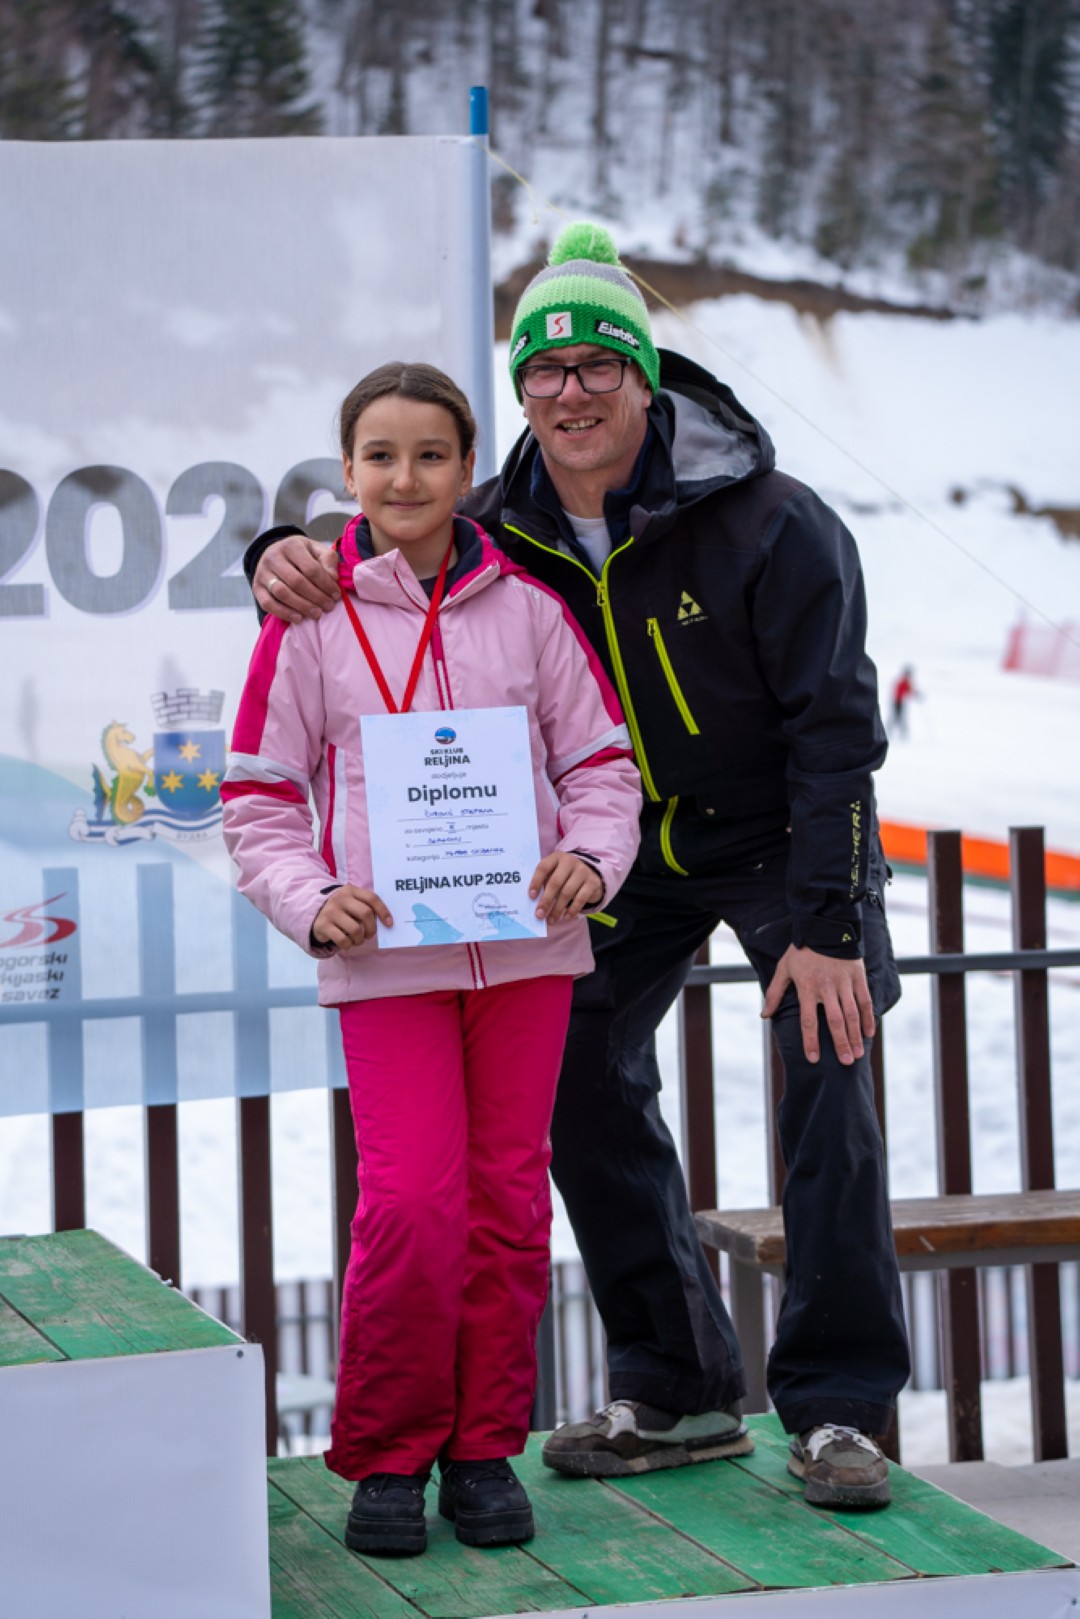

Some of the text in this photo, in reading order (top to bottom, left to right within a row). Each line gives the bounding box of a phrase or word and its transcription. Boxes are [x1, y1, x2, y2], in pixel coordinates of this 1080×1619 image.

[407, 784, 498, 806] Diplomu
[453, 874, 484, 888] KUP
[486, 871, 521, 886] 2026
